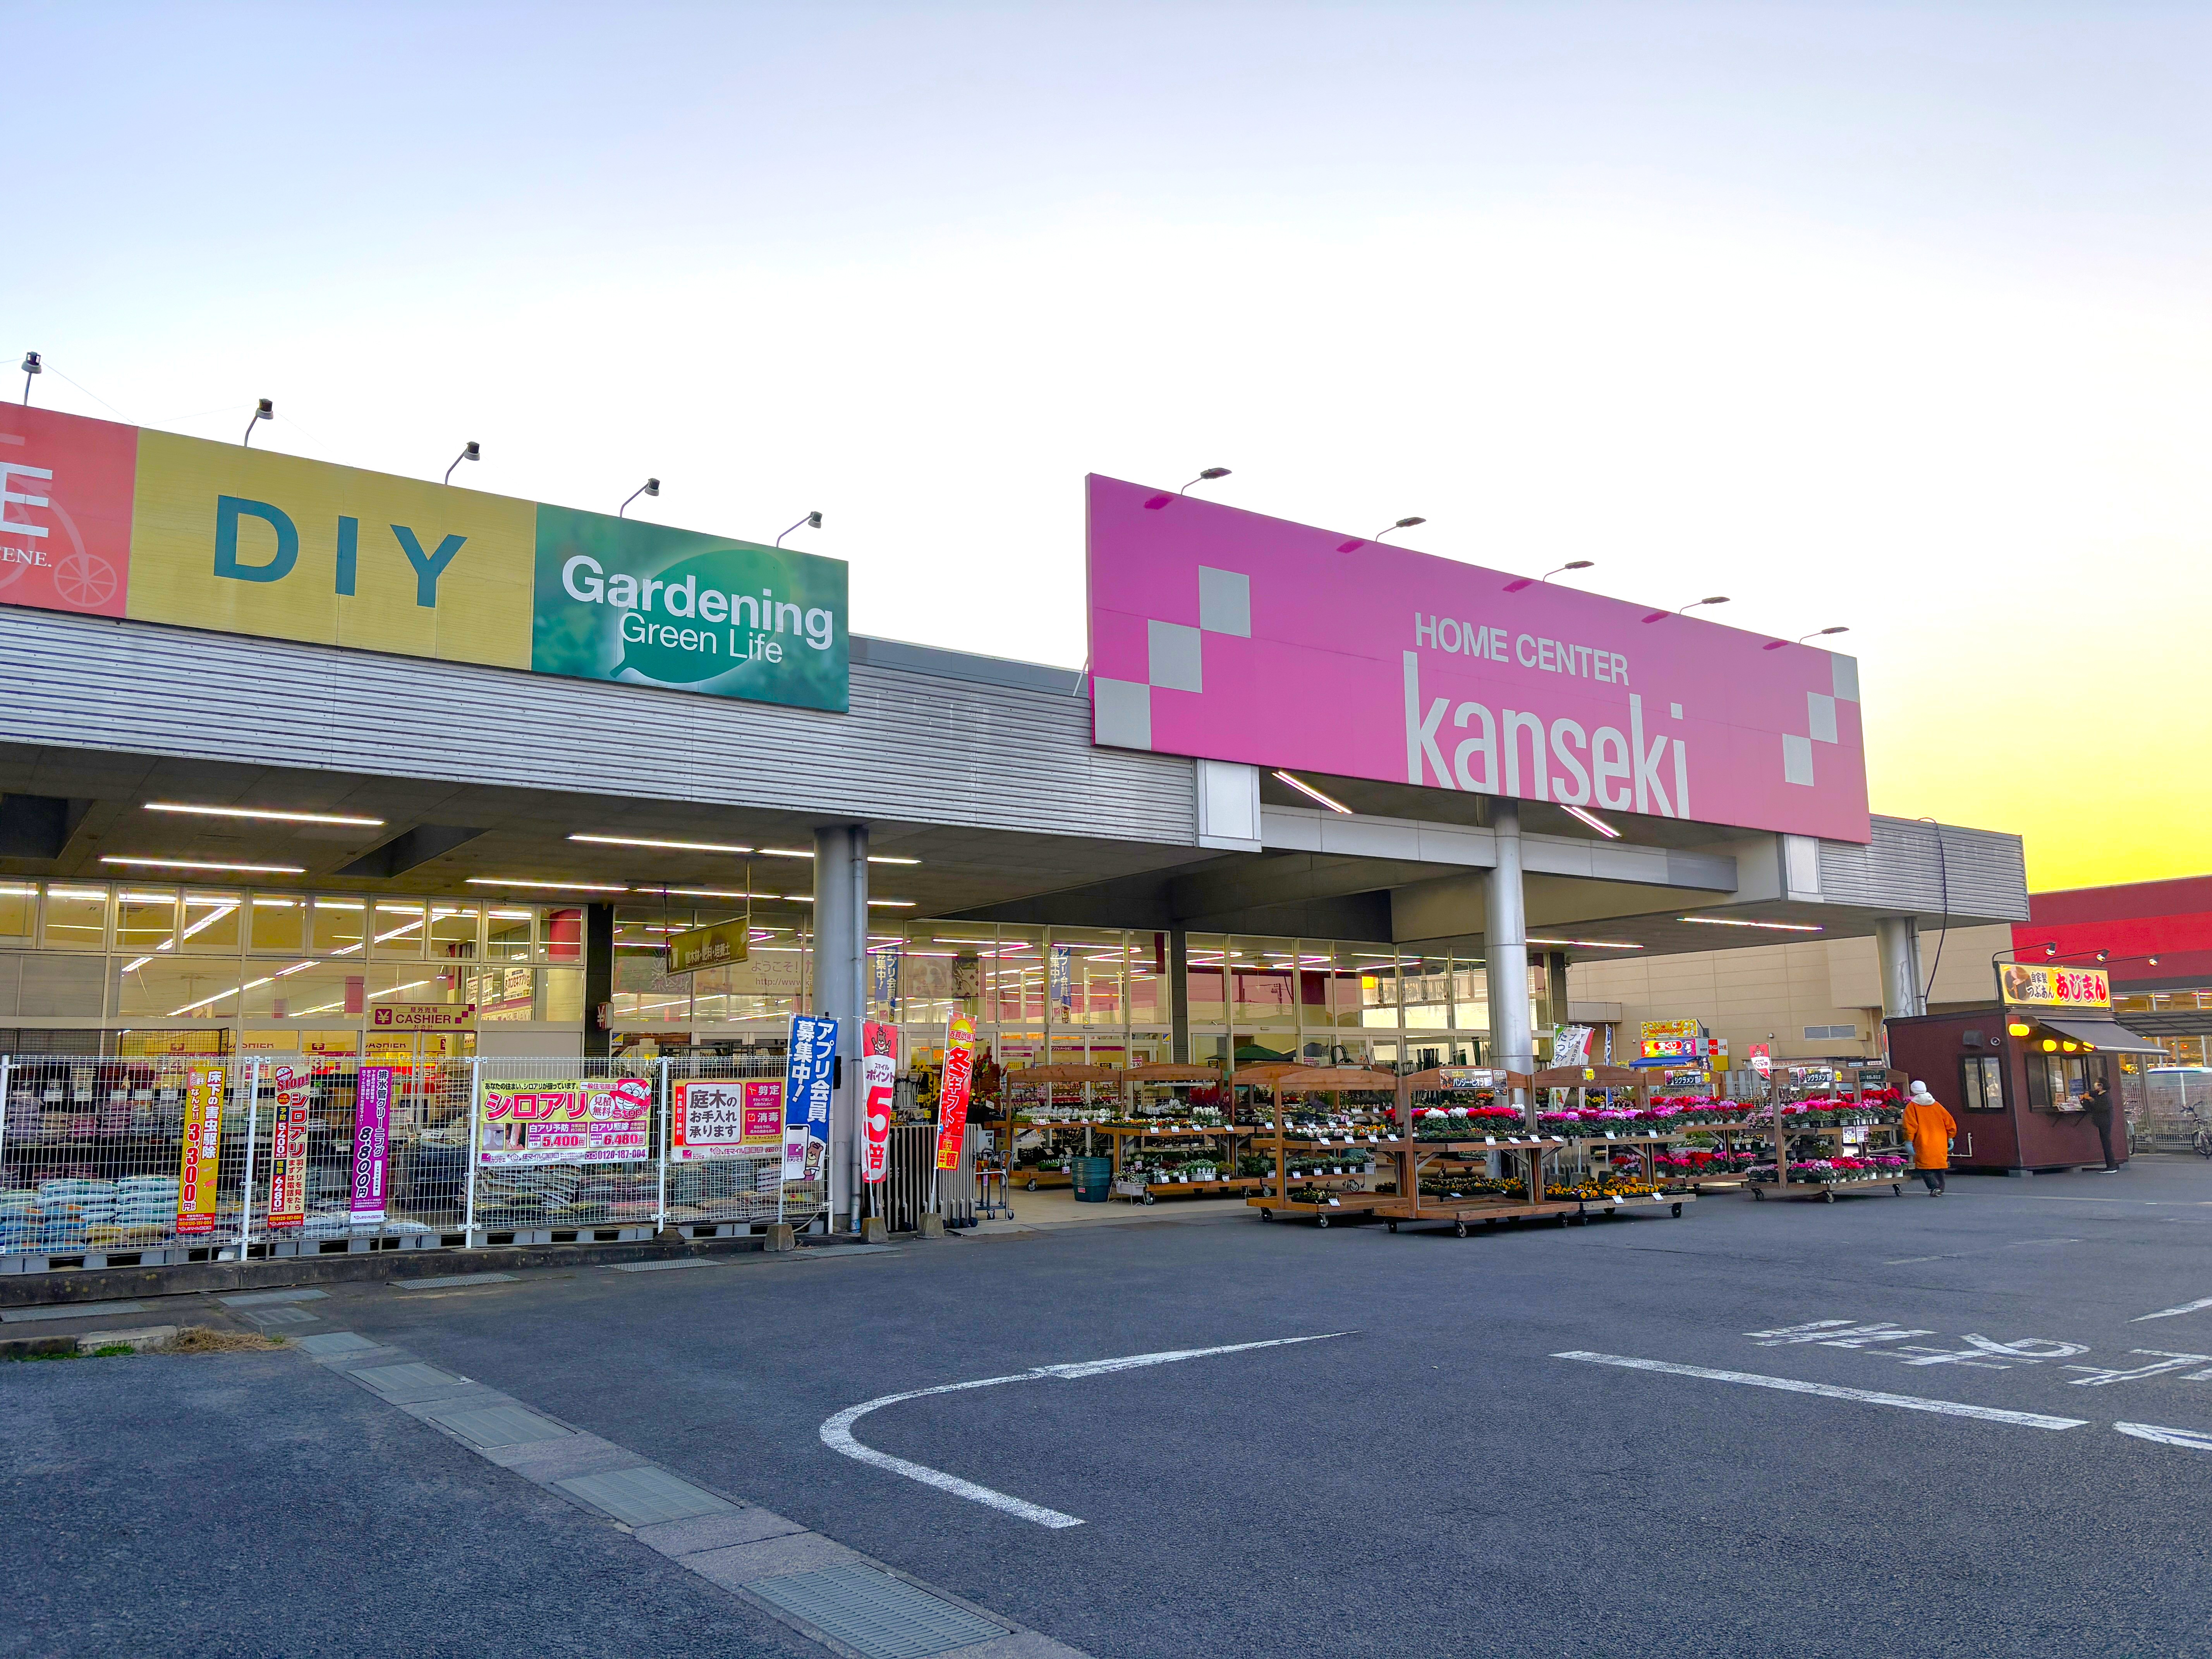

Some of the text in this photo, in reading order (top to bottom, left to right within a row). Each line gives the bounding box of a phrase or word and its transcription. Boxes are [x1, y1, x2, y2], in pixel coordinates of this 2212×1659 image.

[562, 555, 833, 650] Gardening
[619, 613, 783, 663] Green Life
[1415, 612, 1629, 686] HOME CENTER
[1403, 651, 1690, 820] kanseki
[2031, 972, 2048, 984] 自家製
[2027, 985, 2055, 1000] つぶあん
[2056, 972, 2108, 1003] あじまん
[396, 1015, 451, 1024] CASHIER
[1658, 1042, 1677, 1050] 宝くじ
[792, 1020, 816, 1103] 募集中!
[807, 1022, 835, 1123] アプリ会員
[866, 1070, 895, 1083] ポイント
[277, 1073, 310, 1092] Stop!
[945, 1046, 971, 1128] 冬ギフト
[758, 1085, 780, 1096] 剪定
[485, 1091, 588, 1121] シロアリ
[594, 1096, 612, 1107] 見積
[690, 1090, 737, 1109] 庭木の
[202, 1070, 223, 1159] 床下の害虫駆除
[280, 1107, 287, 1121] 予防
[374, 1070, 389, 1157] 排水管クリーニング
[592, 1106, 611, 1116] 無料
[612, 1106, 647, 1119] Stop!
[690, 1110, 737, 1123] お手入れ
[757, 1112, 779, 1123] 消毒
[289, 1092, 309, 1158] シロアリ
[529, 1123, 569, 1133] 白アリ予防
[591, 1122, 629, 1132] 白アリ駆除
[689, 1125, 737, 1138] 承ります
[598, 1149, 646, 1159] 0120-187-004
[295, 1159, 303, 1211] 羽アリを見たら
